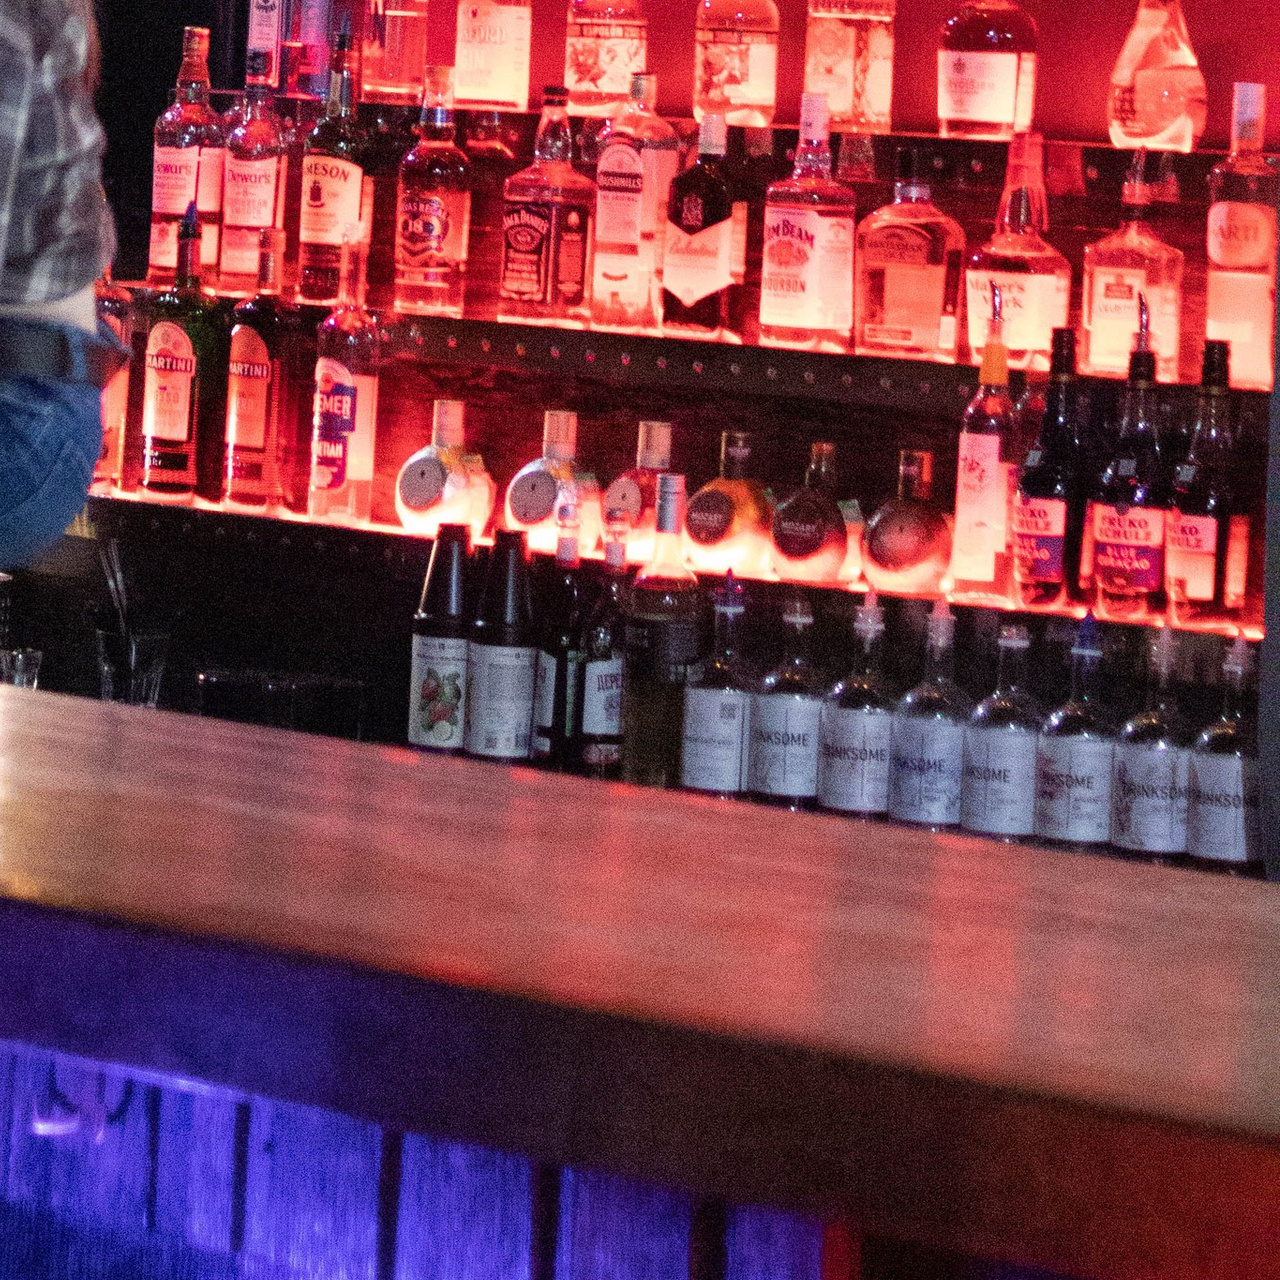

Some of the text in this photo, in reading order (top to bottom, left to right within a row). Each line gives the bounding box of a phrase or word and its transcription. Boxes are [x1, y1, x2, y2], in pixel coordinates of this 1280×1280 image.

[157, 163, 192, 175] ewar's
[305, 161, 350, 183] MESON
[599, 175, 644, 188] BUSHMILLS
[781, 219, 815, 250] BEAM
[781, 519, 816, 533] MOZART
[824, 742, 887, 762] RINKSOME
